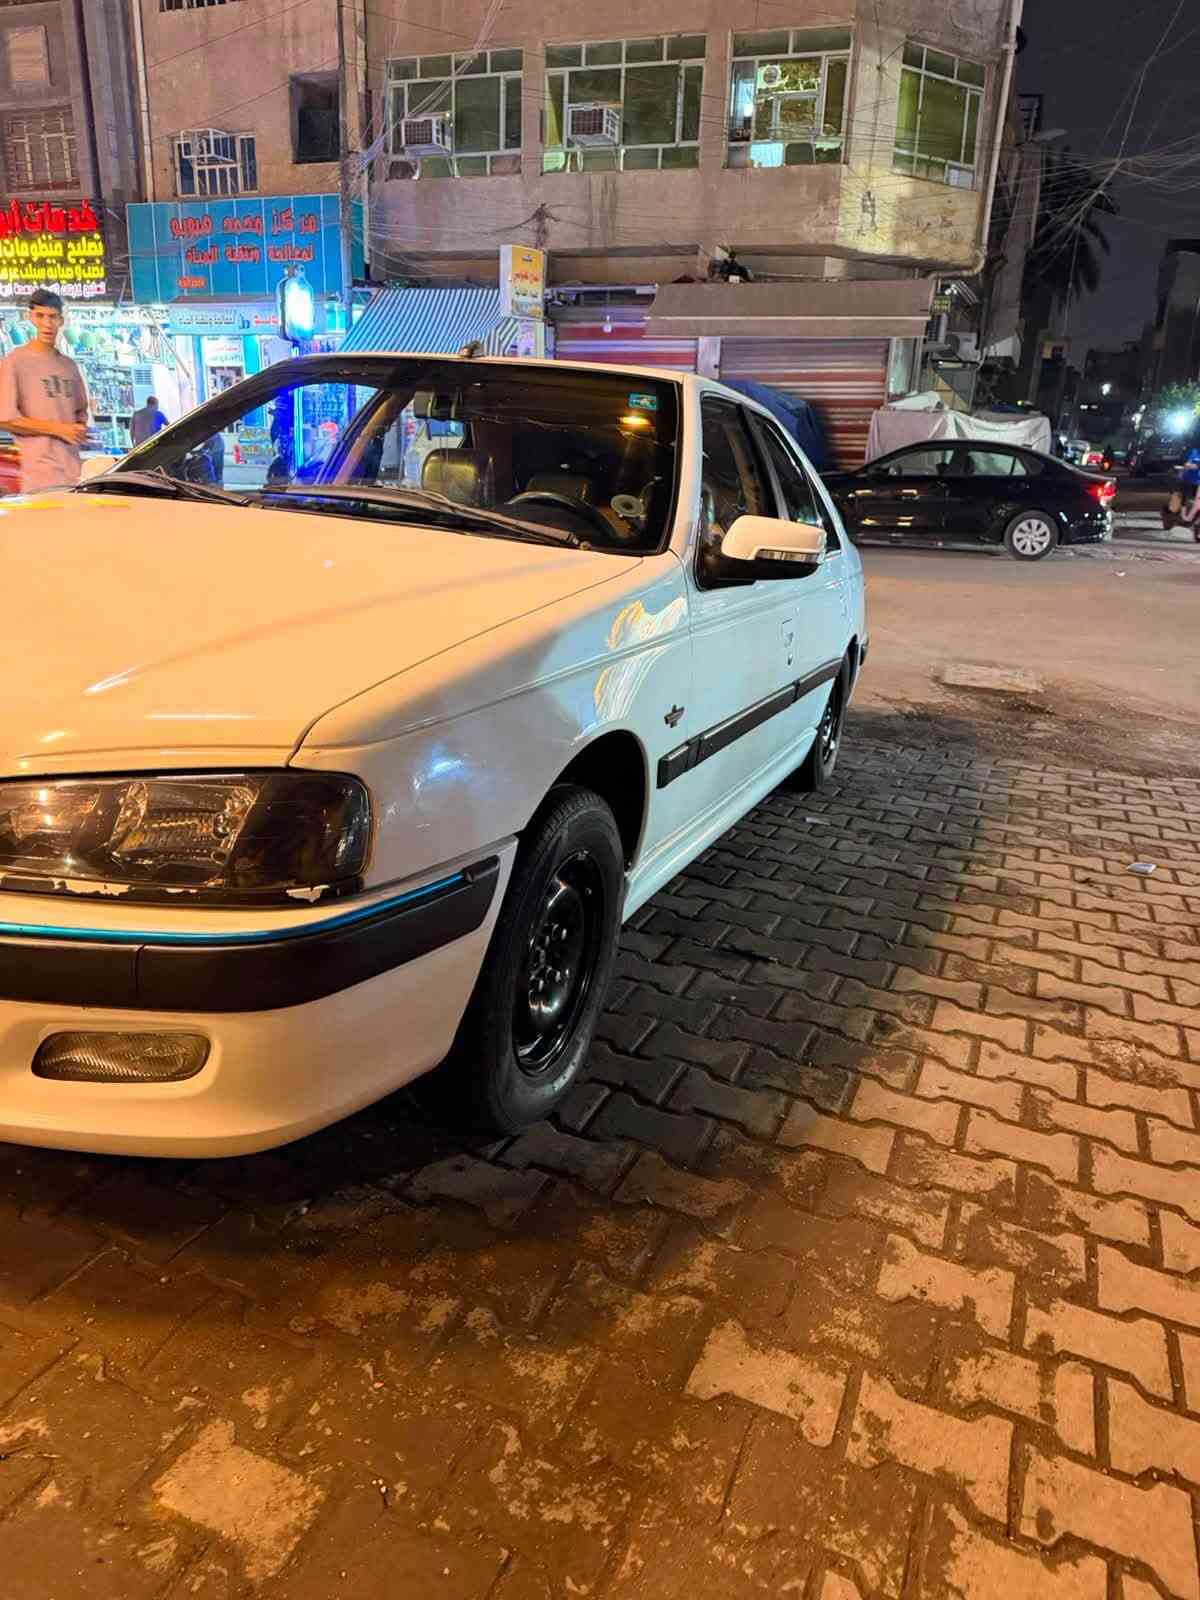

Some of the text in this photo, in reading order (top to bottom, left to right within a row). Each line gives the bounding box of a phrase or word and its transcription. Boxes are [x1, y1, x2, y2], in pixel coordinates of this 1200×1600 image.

[23, 199, 97, 233] خدمات
[3, 234, 64, 262] منظومات
[67, 235, 104, 263] تصليح
